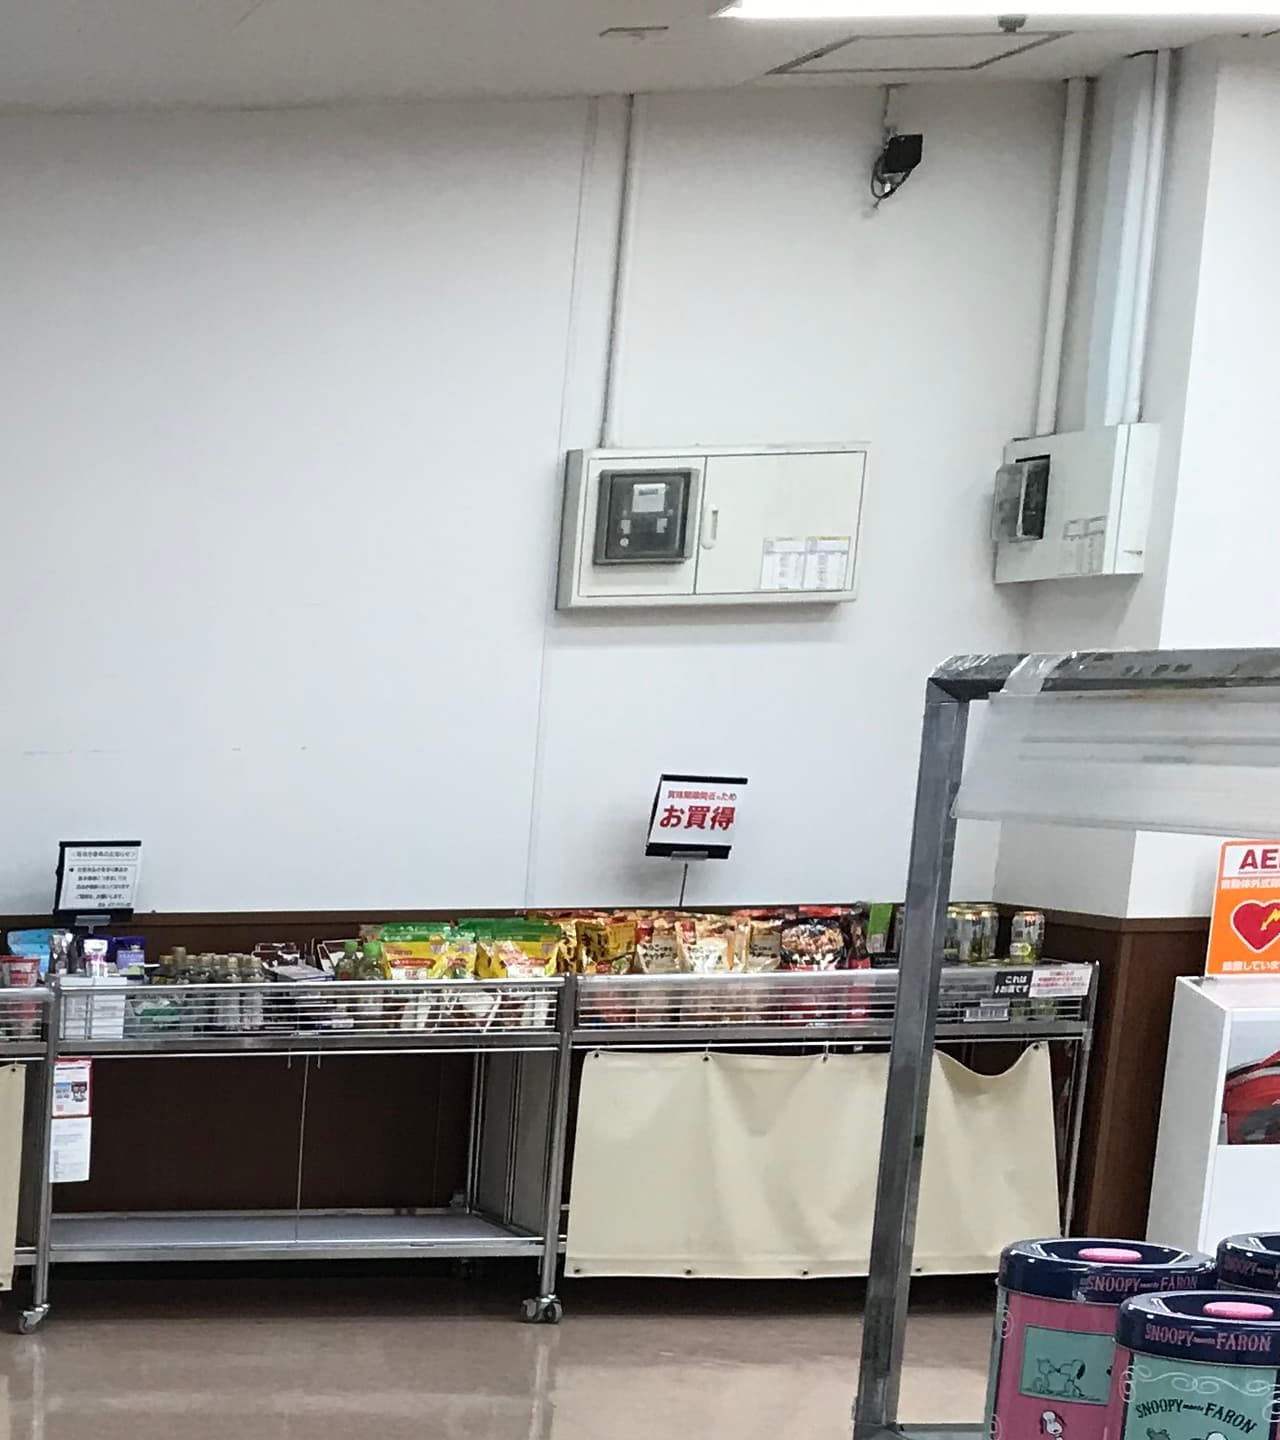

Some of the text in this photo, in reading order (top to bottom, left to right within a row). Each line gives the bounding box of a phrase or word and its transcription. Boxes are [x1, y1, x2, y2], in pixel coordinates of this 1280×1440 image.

[660, 804, 735, 830] お買得
[1239, 849, 1280, 870] AE
[1087, 1275, 1141, 1292] SNOOPY
[1160, 1275, 1199, 1290] FARON
[1145, 1323, 1194, 1347] SNOOPY
[1216, 1332, 1271, 1351] FARON
[1135, 1399, 1183, 1418] SNOOPY
[1204, 1403, 1258, 1434] FARON
